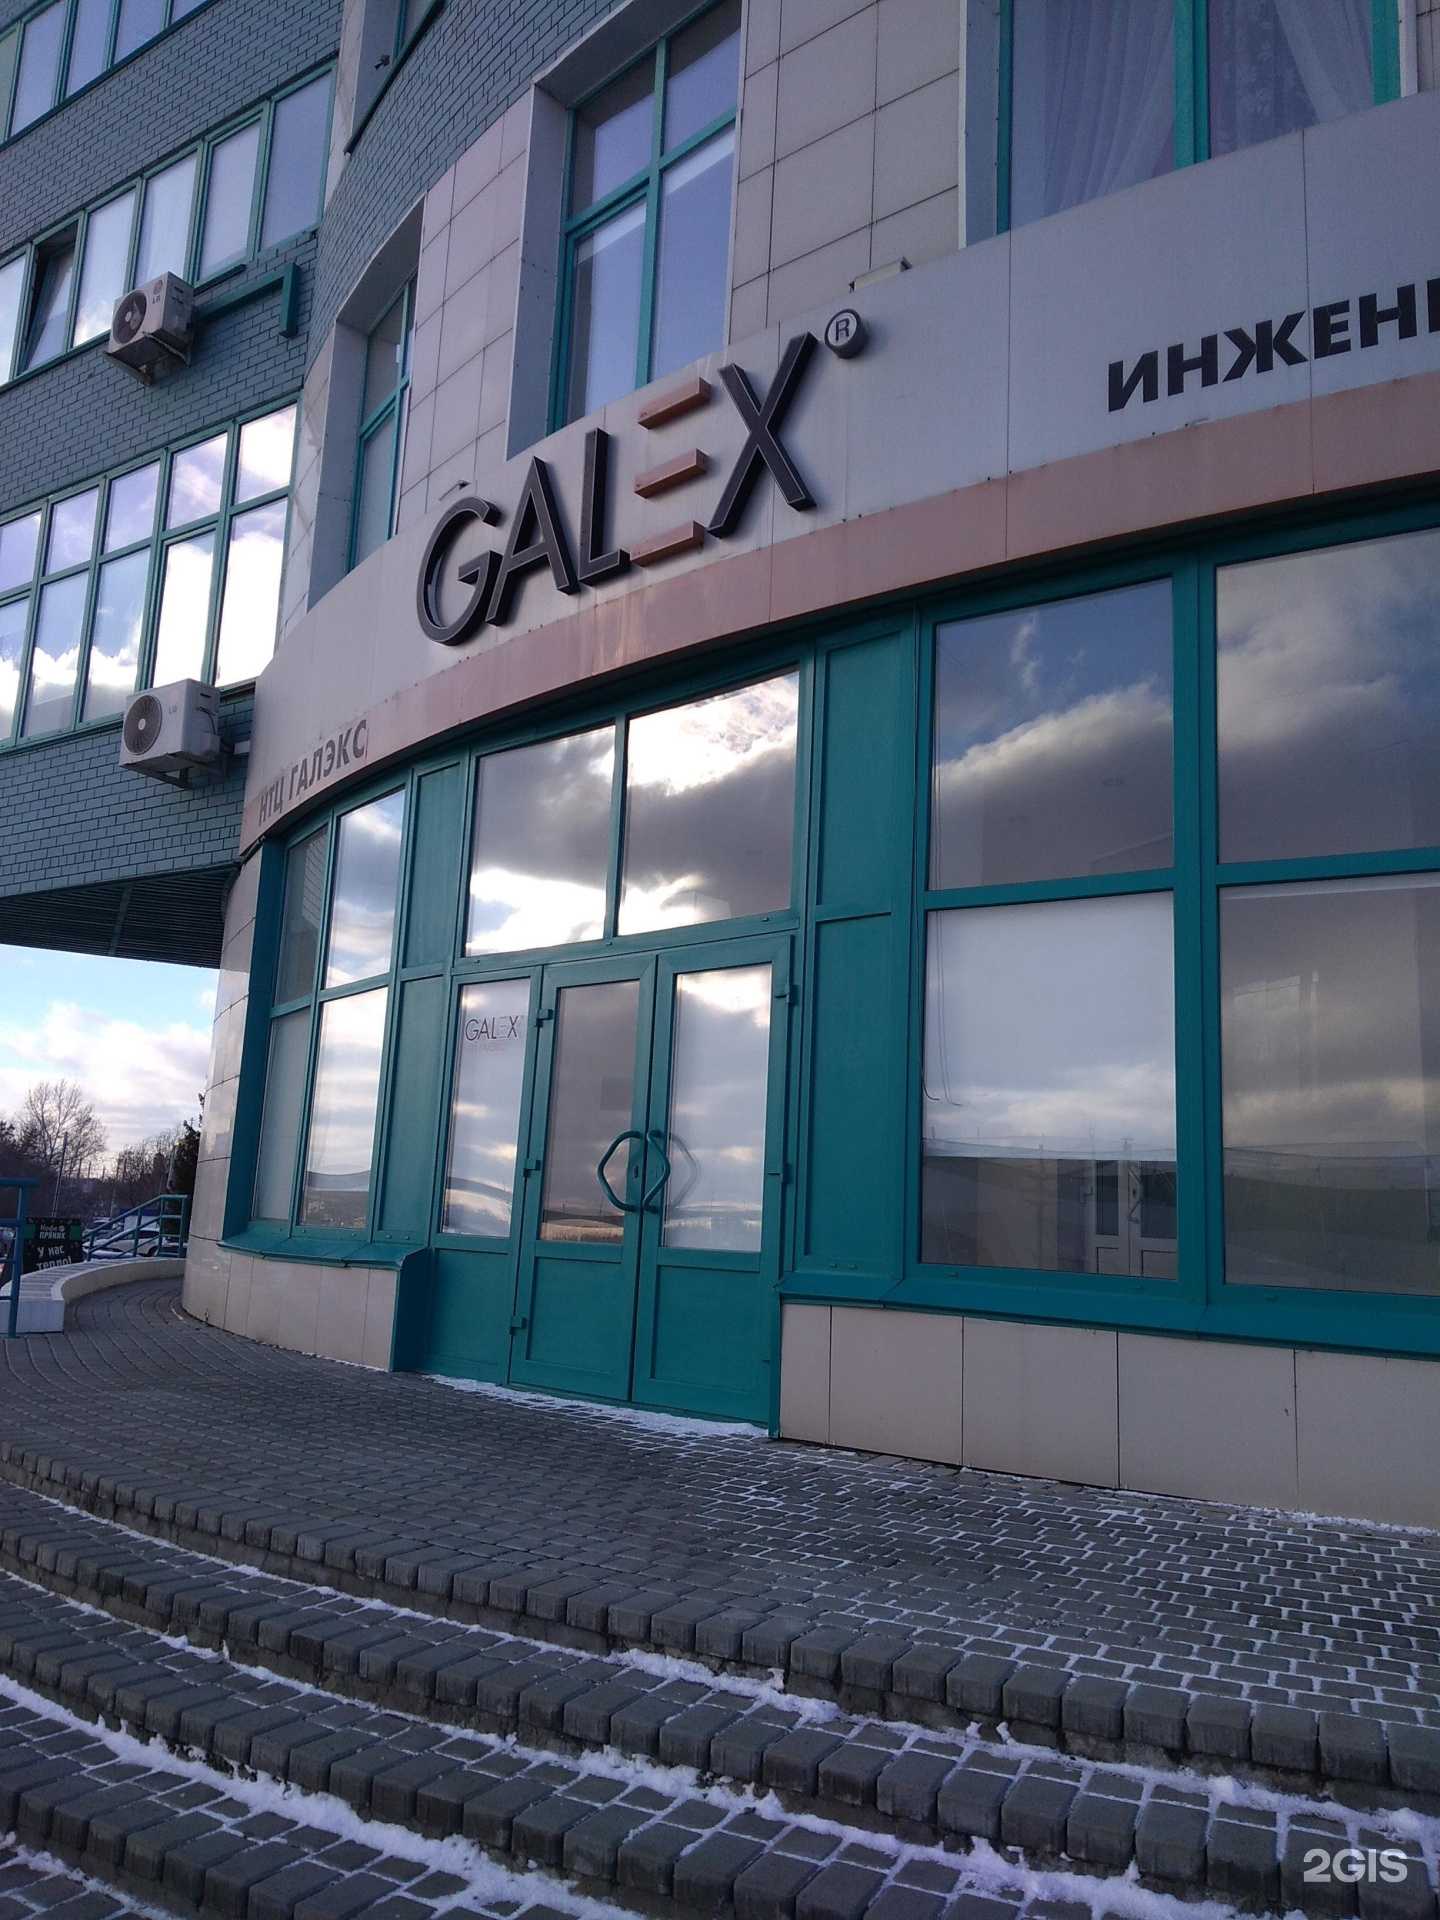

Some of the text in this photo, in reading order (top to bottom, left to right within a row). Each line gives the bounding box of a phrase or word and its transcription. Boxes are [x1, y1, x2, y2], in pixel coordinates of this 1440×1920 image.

[259, 719, 367, 826] НТЦ ГАЛЭКС
[465, 1016, 519, 1041] GALEX
